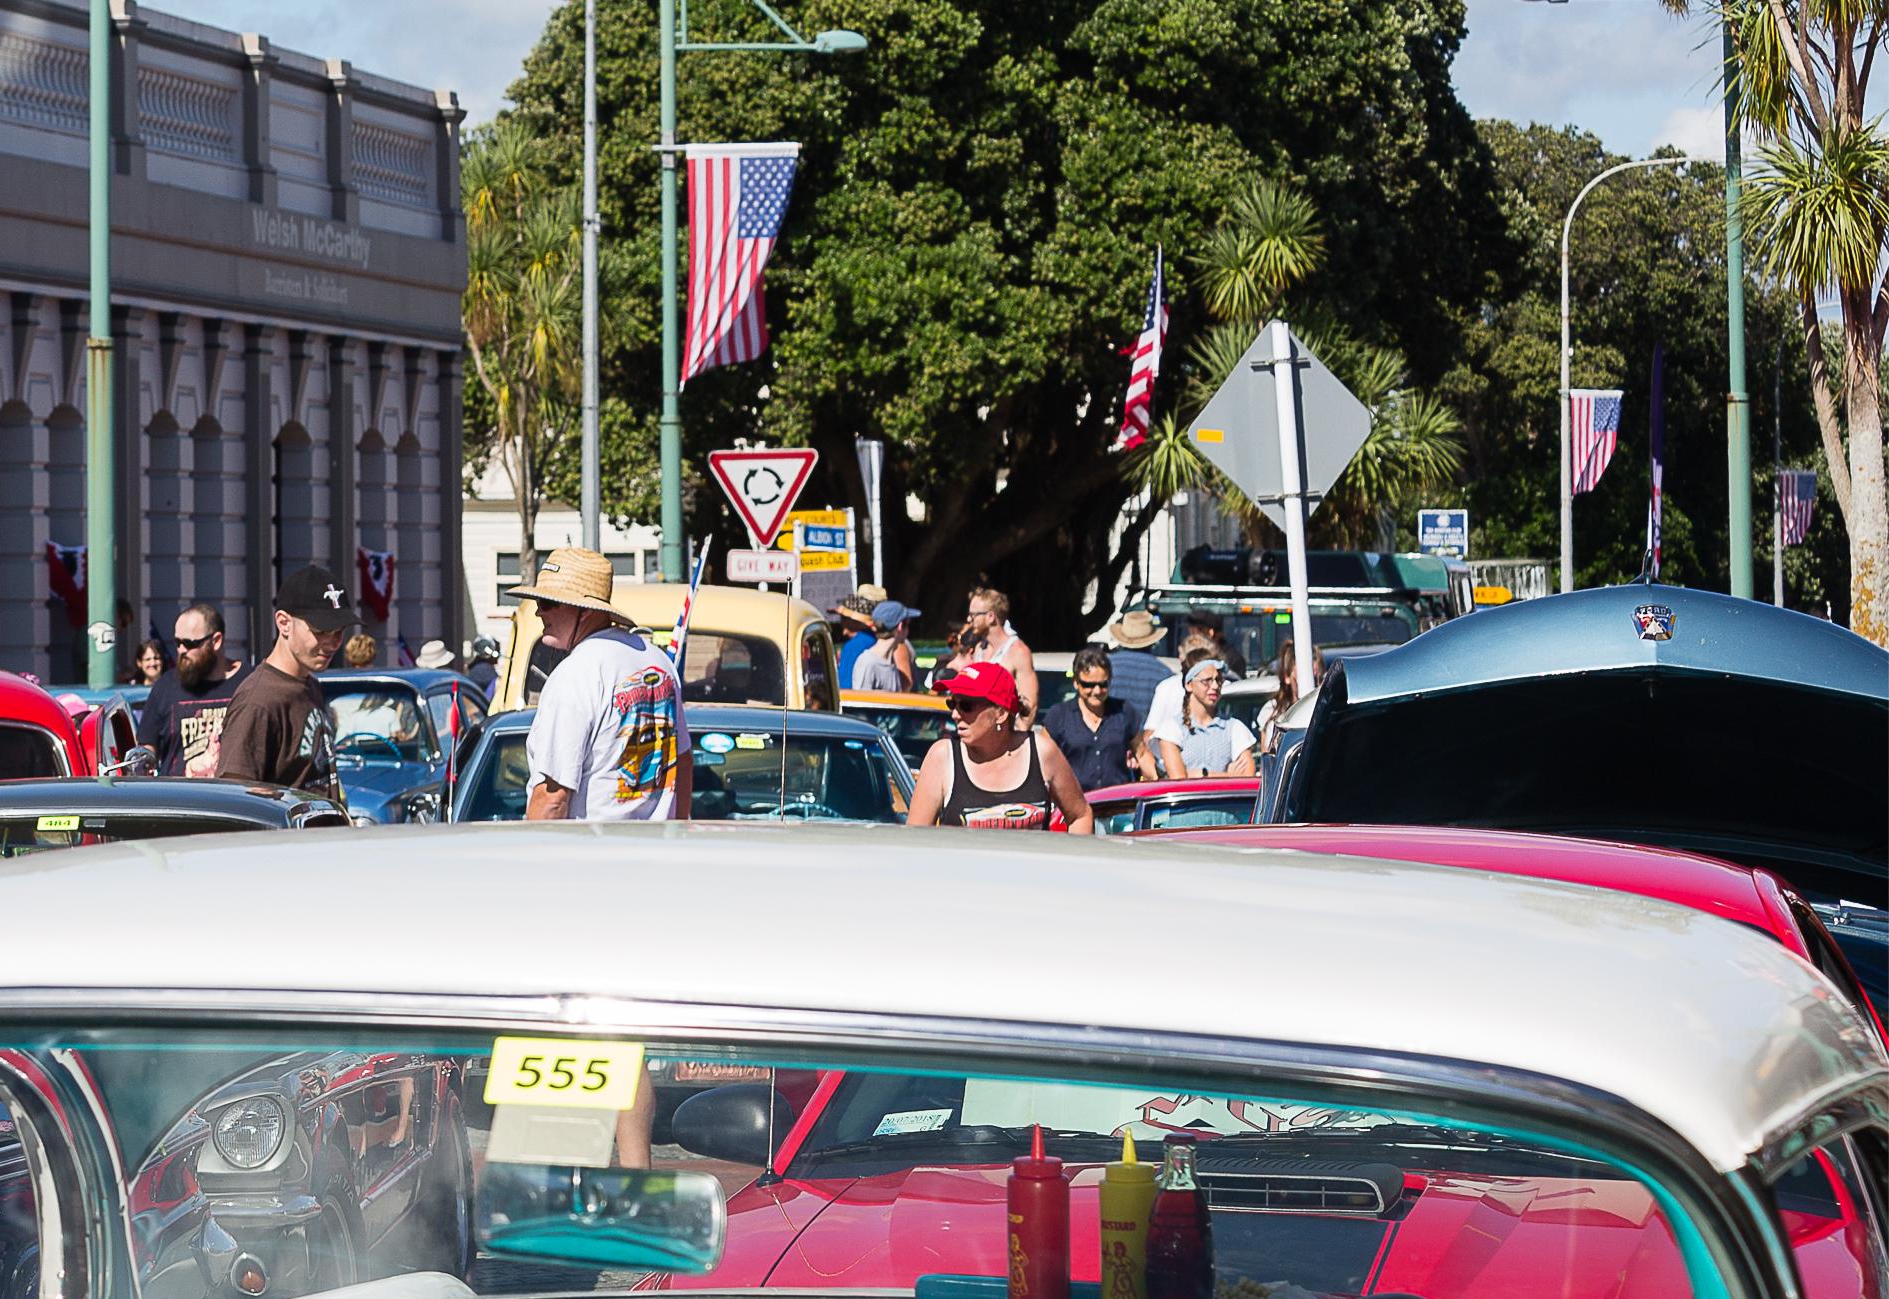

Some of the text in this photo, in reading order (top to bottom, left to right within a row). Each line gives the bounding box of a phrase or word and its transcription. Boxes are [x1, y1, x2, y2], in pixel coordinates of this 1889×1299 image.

[252, 207, 370, 270] Welsh McCarthy
[737, 560, 789, 573] GIVE WAY
[514, 1056, 611, 1092] 555
